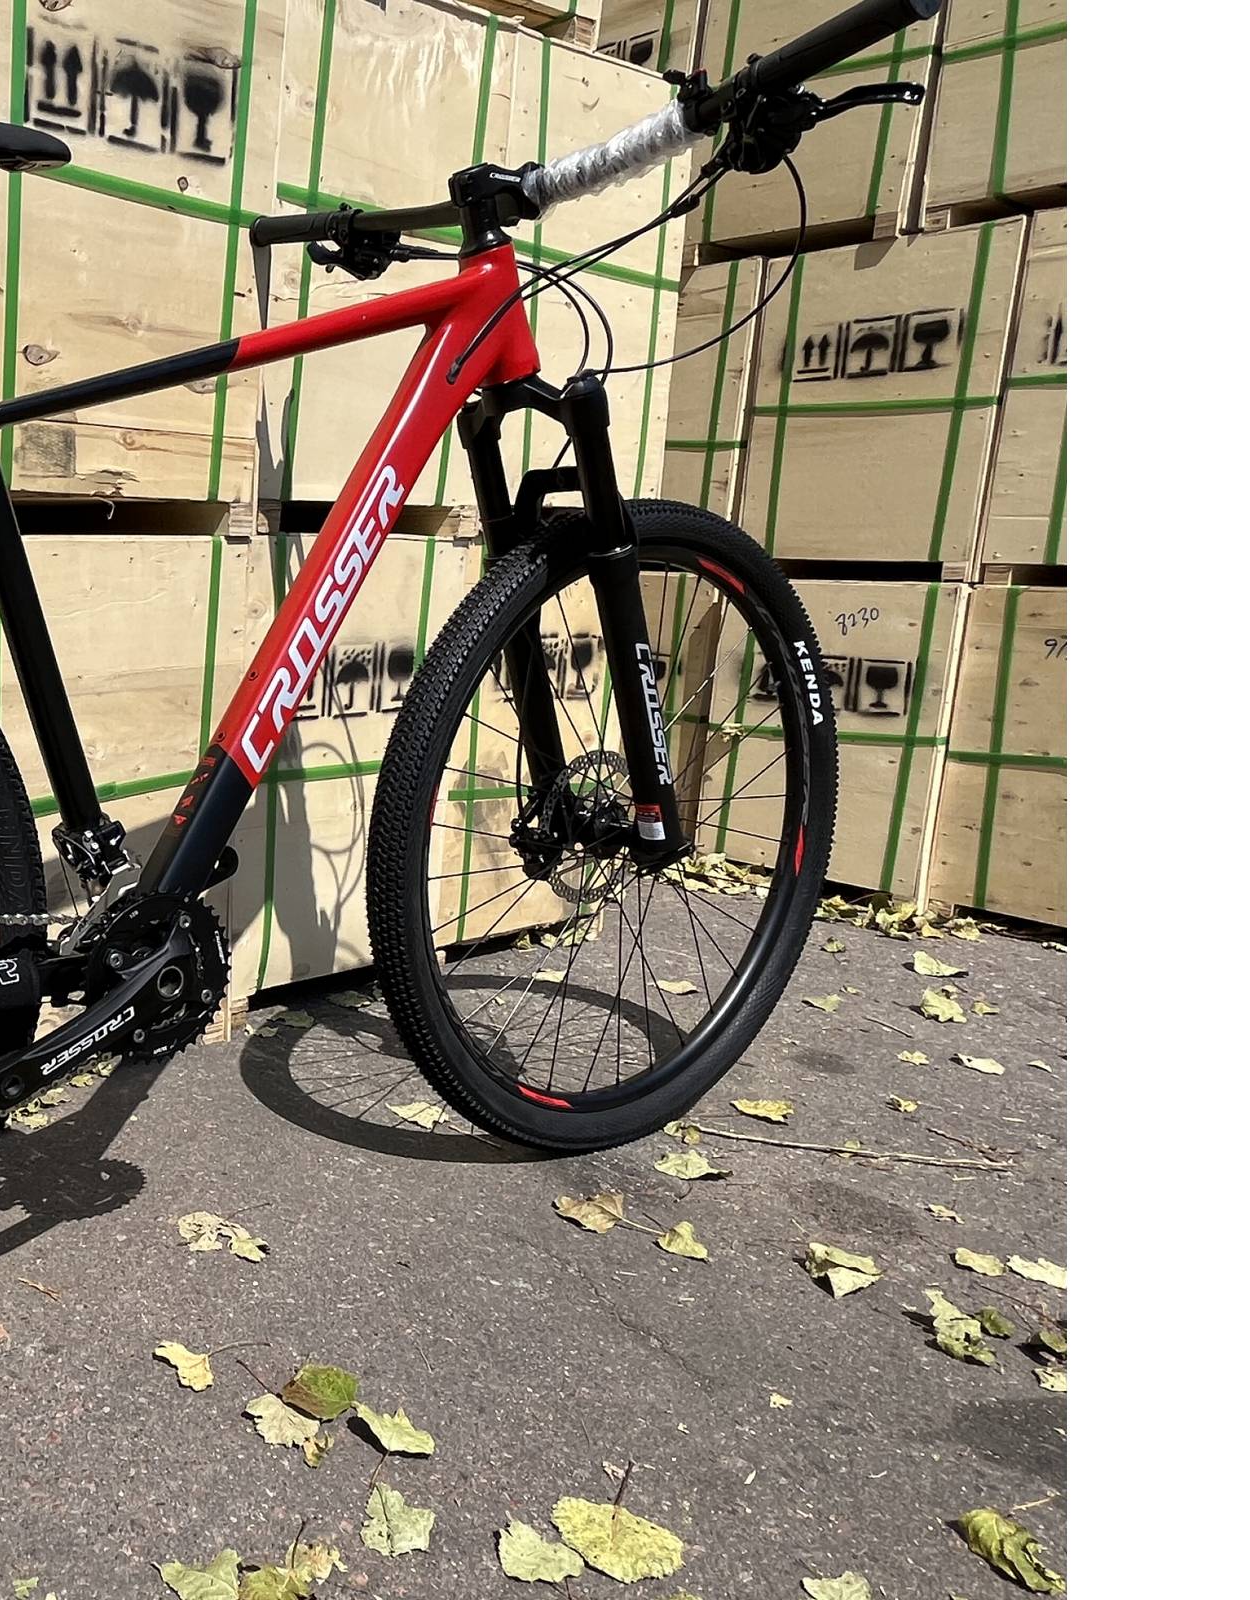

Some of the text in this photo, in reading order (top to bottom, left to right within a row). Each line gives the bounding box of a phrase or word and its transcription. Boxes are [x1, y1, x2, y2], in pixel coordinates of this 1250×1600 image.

[240, 463, 405, 774] CROSSER
[634, 641, 673, 786] CROSSER
[792, 640, 824, 726] KENDA
[39, 1005, 136, 1077] CROSSER
